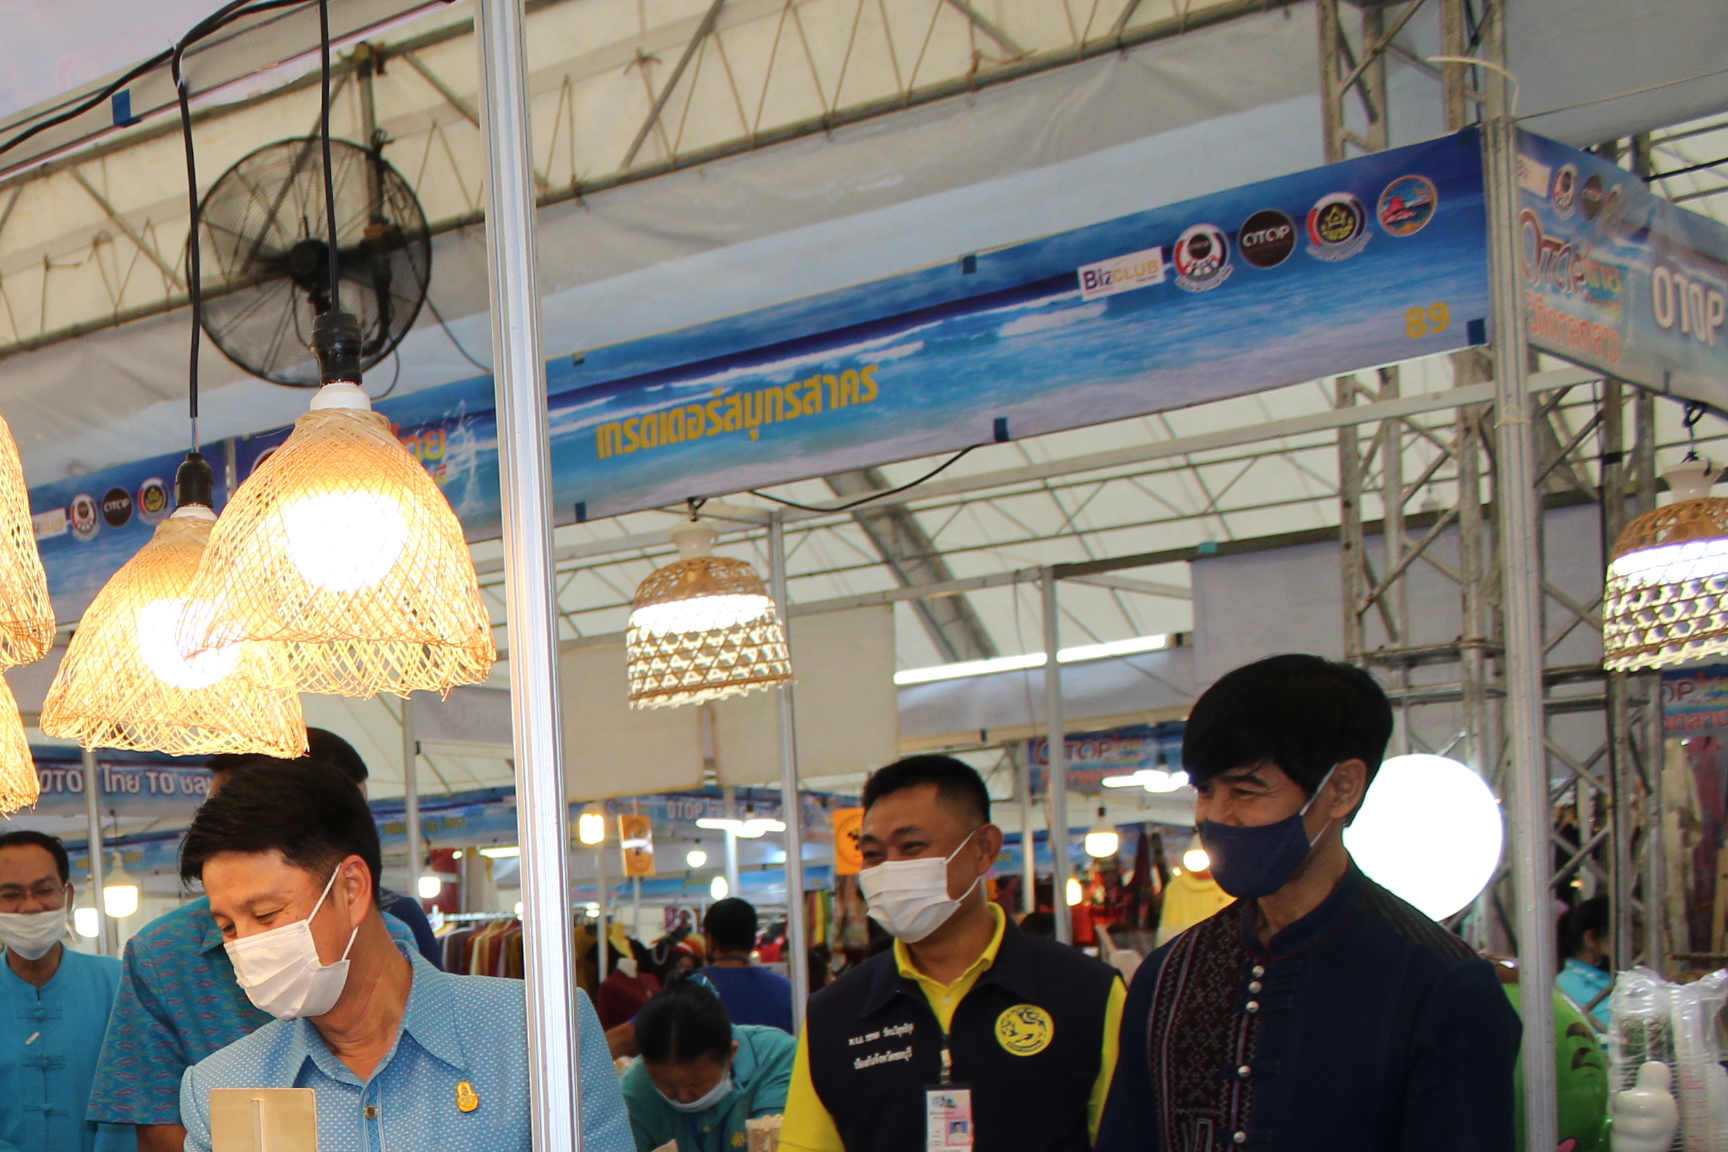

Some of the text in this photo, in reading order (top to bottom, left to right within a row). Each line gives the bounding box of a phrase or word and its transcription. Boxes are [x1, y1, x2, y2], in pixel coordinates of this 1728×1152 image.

[1241, 224, 1291, 248] OTOP
[1403, 301, 1451, 339] 89
[1652, 264, 1724, 348] OTOP
[145, 770, 175, 795] TO
